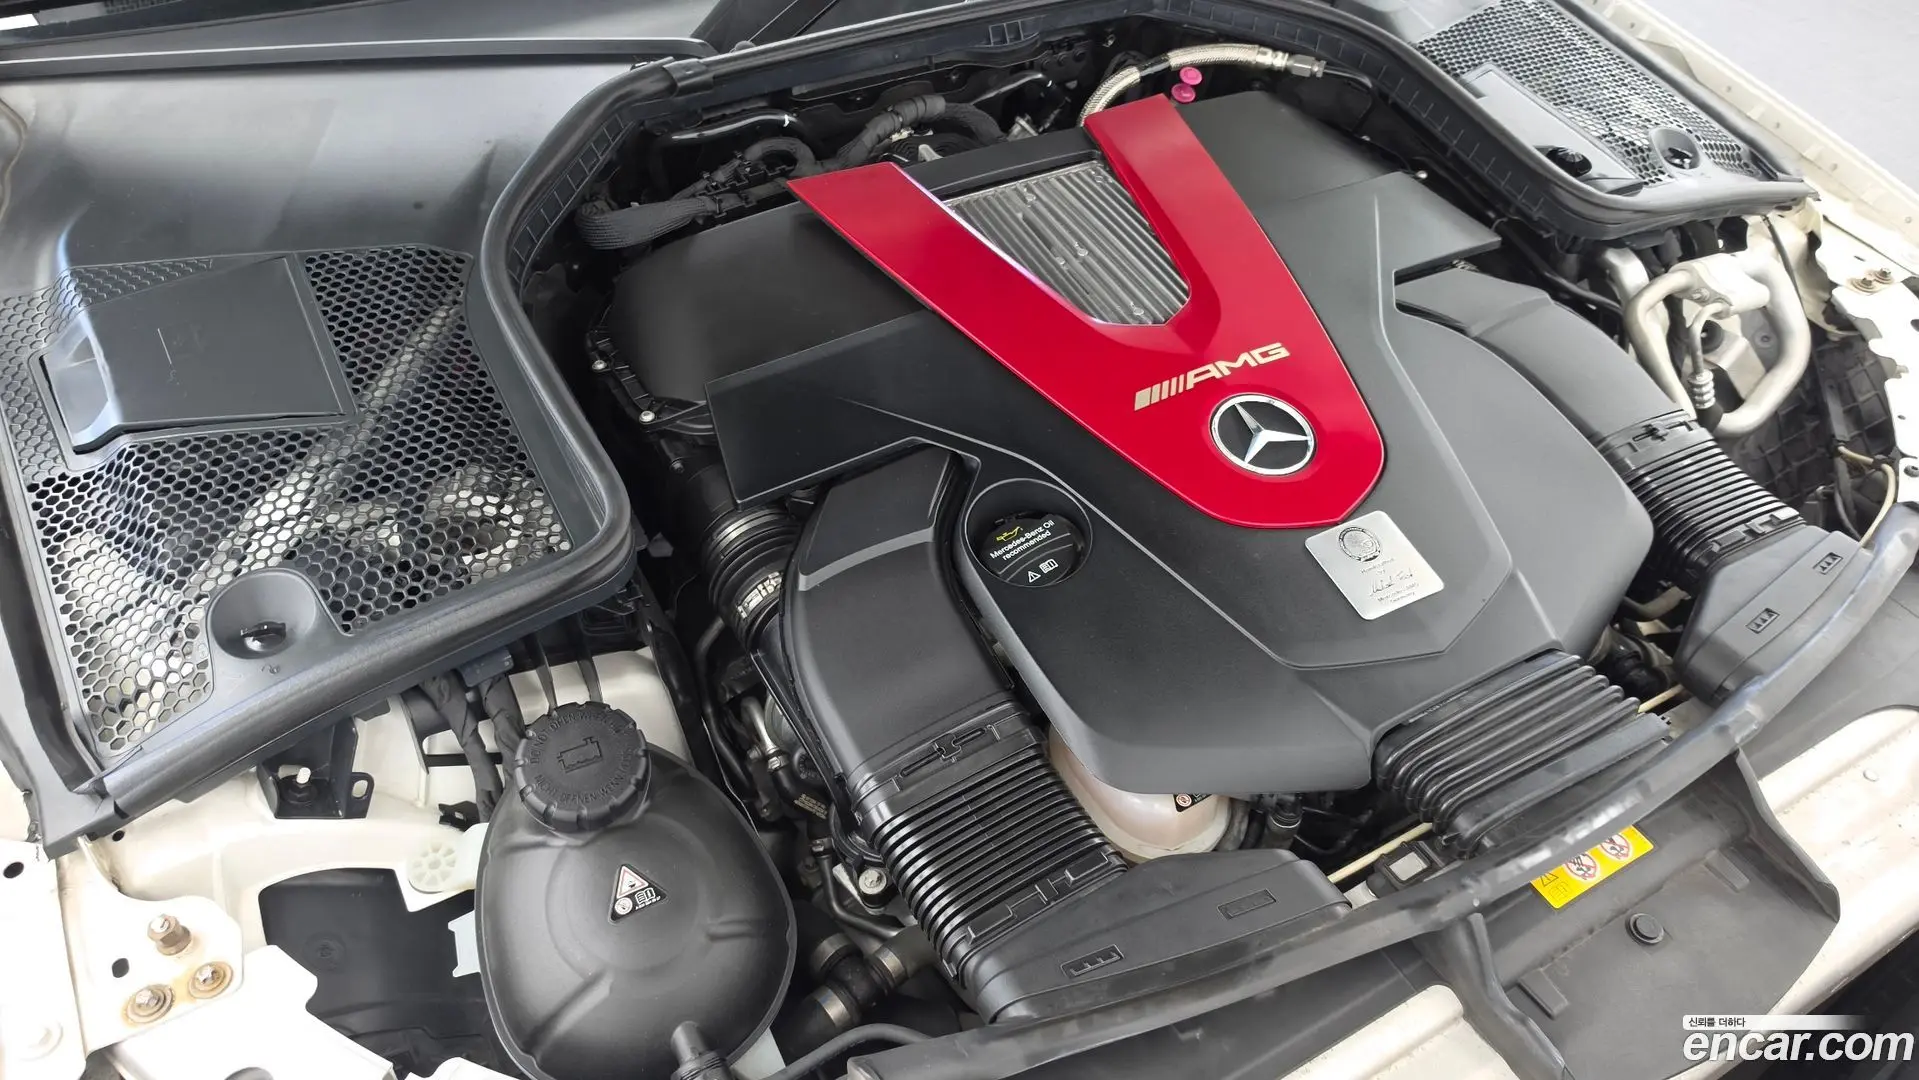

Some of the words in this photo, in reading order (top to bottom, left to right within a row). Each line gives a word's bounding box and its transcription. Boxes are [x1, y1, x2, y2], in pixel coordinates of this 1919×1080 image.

[1186, 342, 1291, 391] AMG
[989, 526, 1045, 559] Mercedes-Benz
[1043, 519, 1055, 529] Oil
[1002, 530, 1052, 561] recommended
